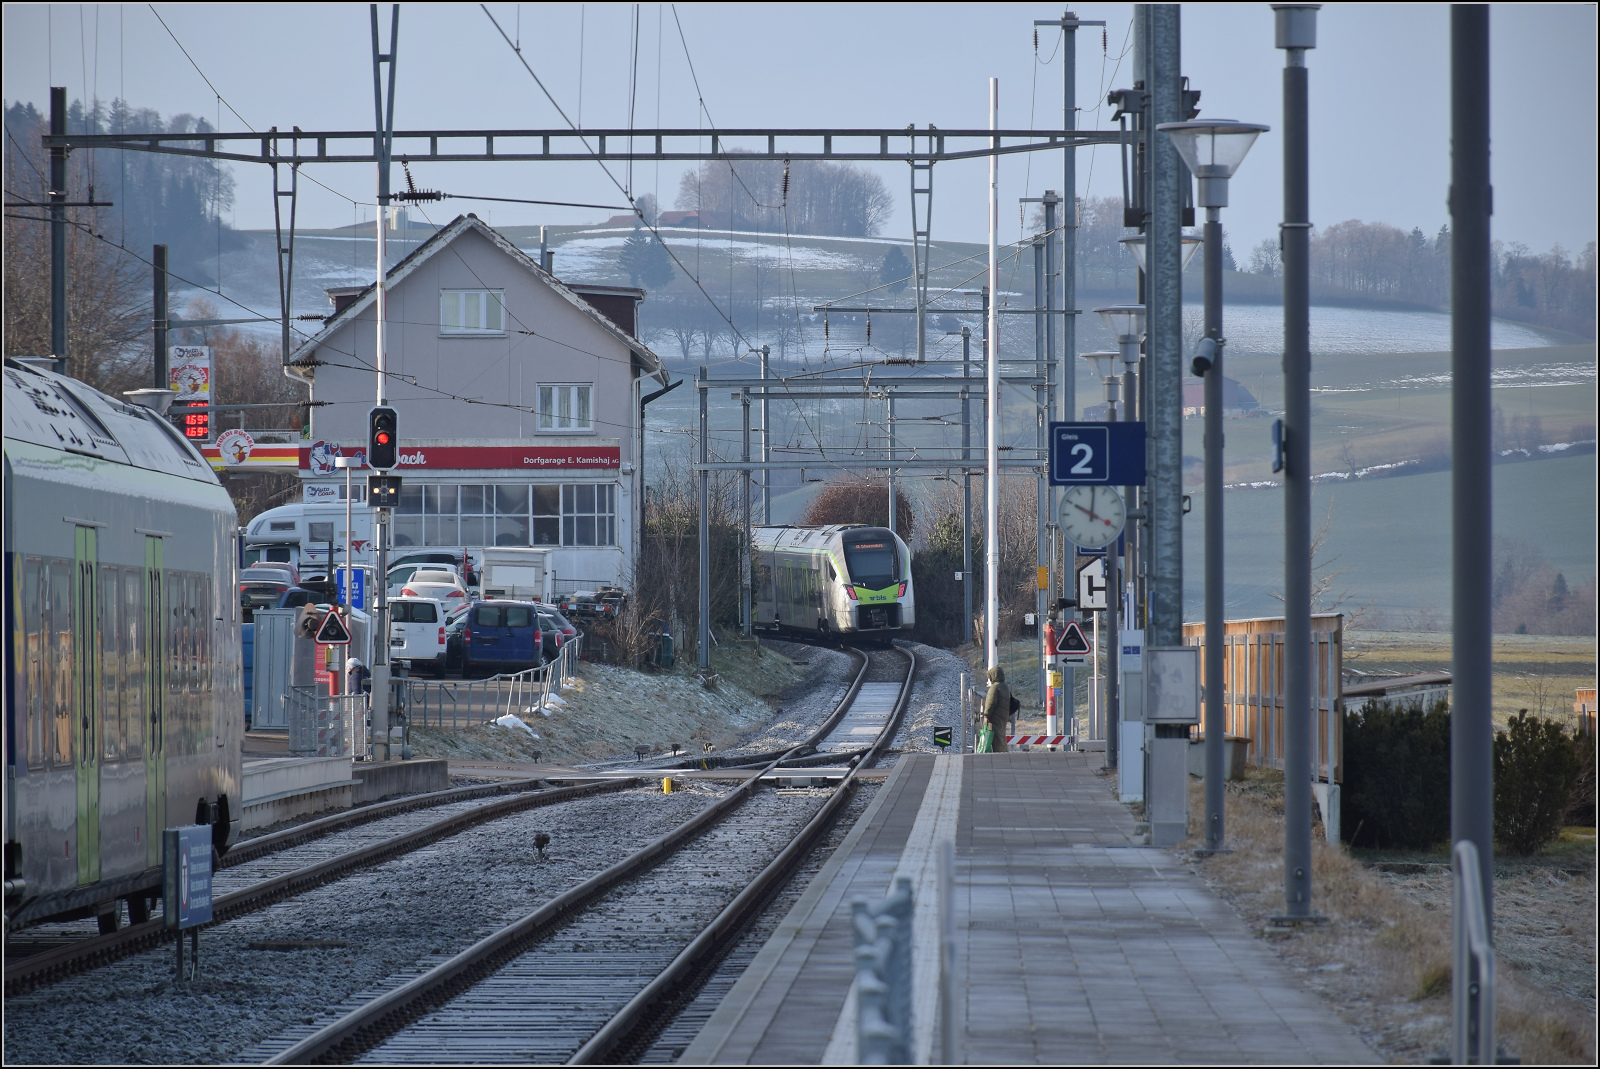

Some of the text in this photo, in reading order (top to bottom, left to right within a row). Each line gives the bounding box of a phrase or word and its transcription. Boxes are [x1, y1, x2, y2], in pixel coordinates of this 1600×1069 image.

[216, 429, 254, 449] RUEDI RÜSSEL
[1061, 433, 1079, 441] Gleis
[398, 450, 427, 464] ach
[523, 457, 565, 465] Dorfgarage
[576, 456, 610, 465] Kamishaj
[1070, 443, 1093, 474] 2
[380, 513, 386, 522] C
